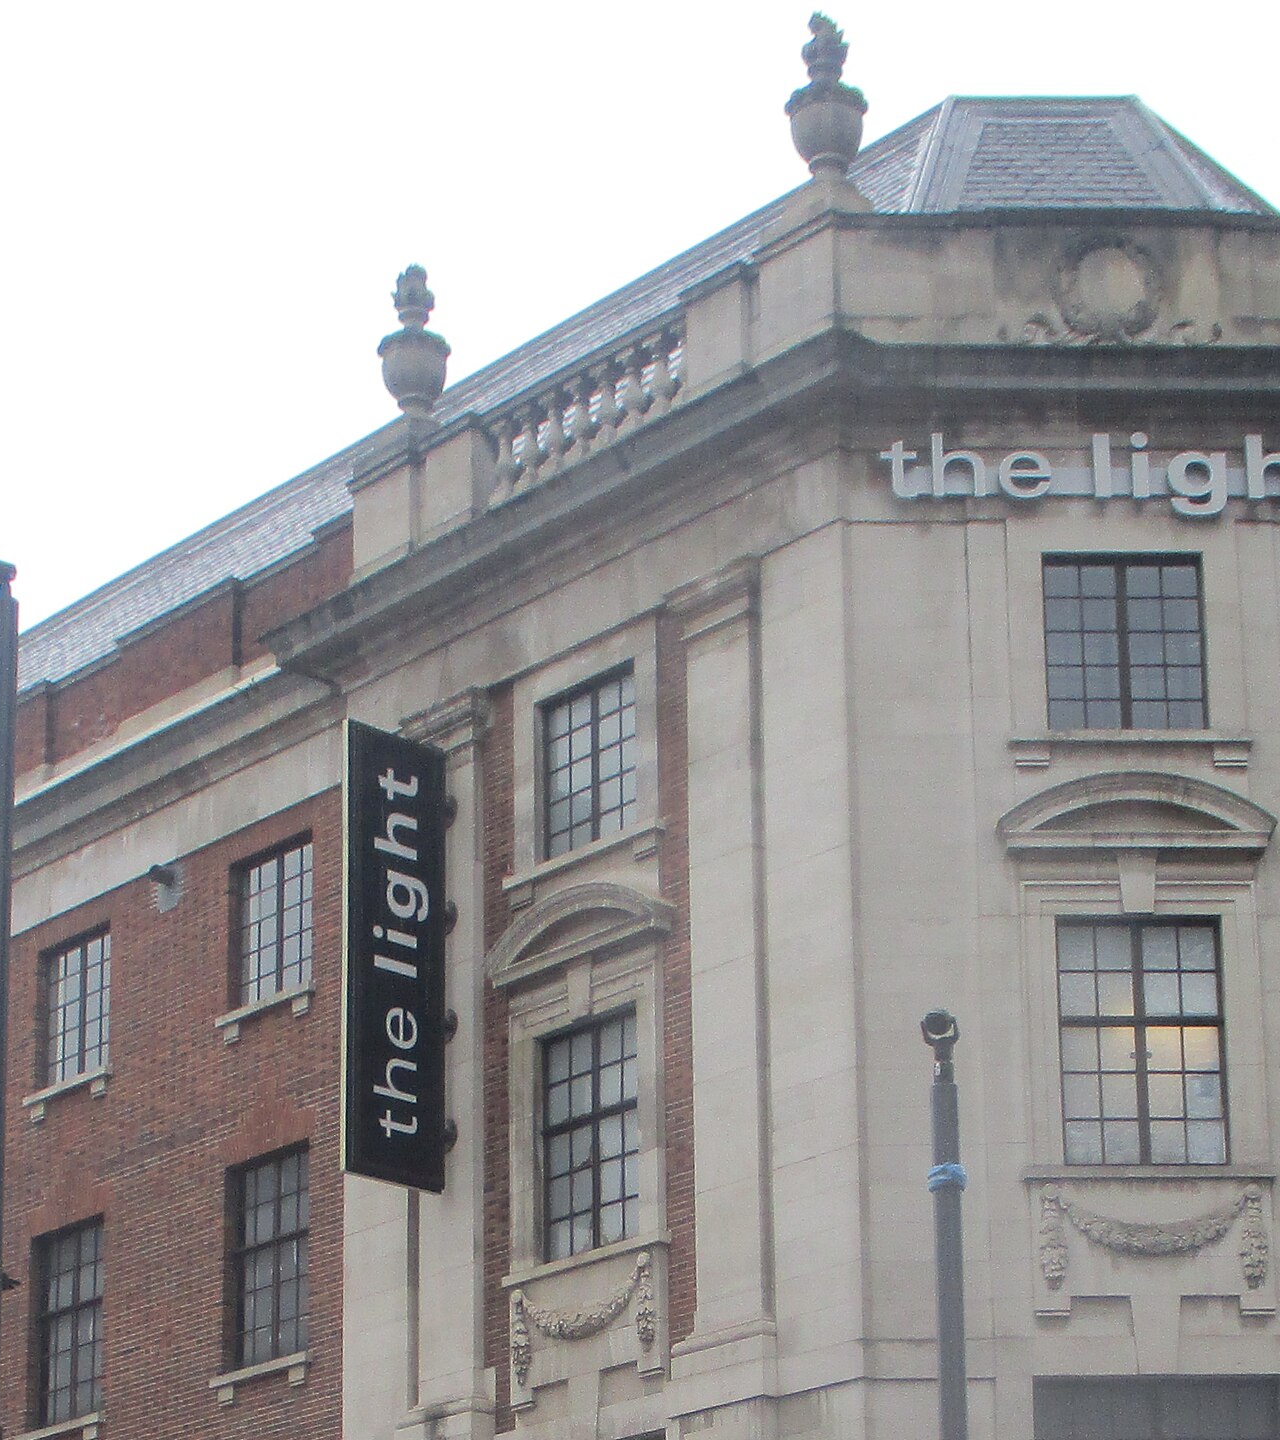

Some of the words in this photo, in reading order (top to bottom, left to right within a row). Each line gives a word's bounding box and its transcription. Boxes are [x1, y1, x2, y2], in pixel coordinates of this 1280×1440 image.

[879, 432, 1052, 500] the
[373, 767, 429, 979] light
[372, 1006, 418, 1139] the
